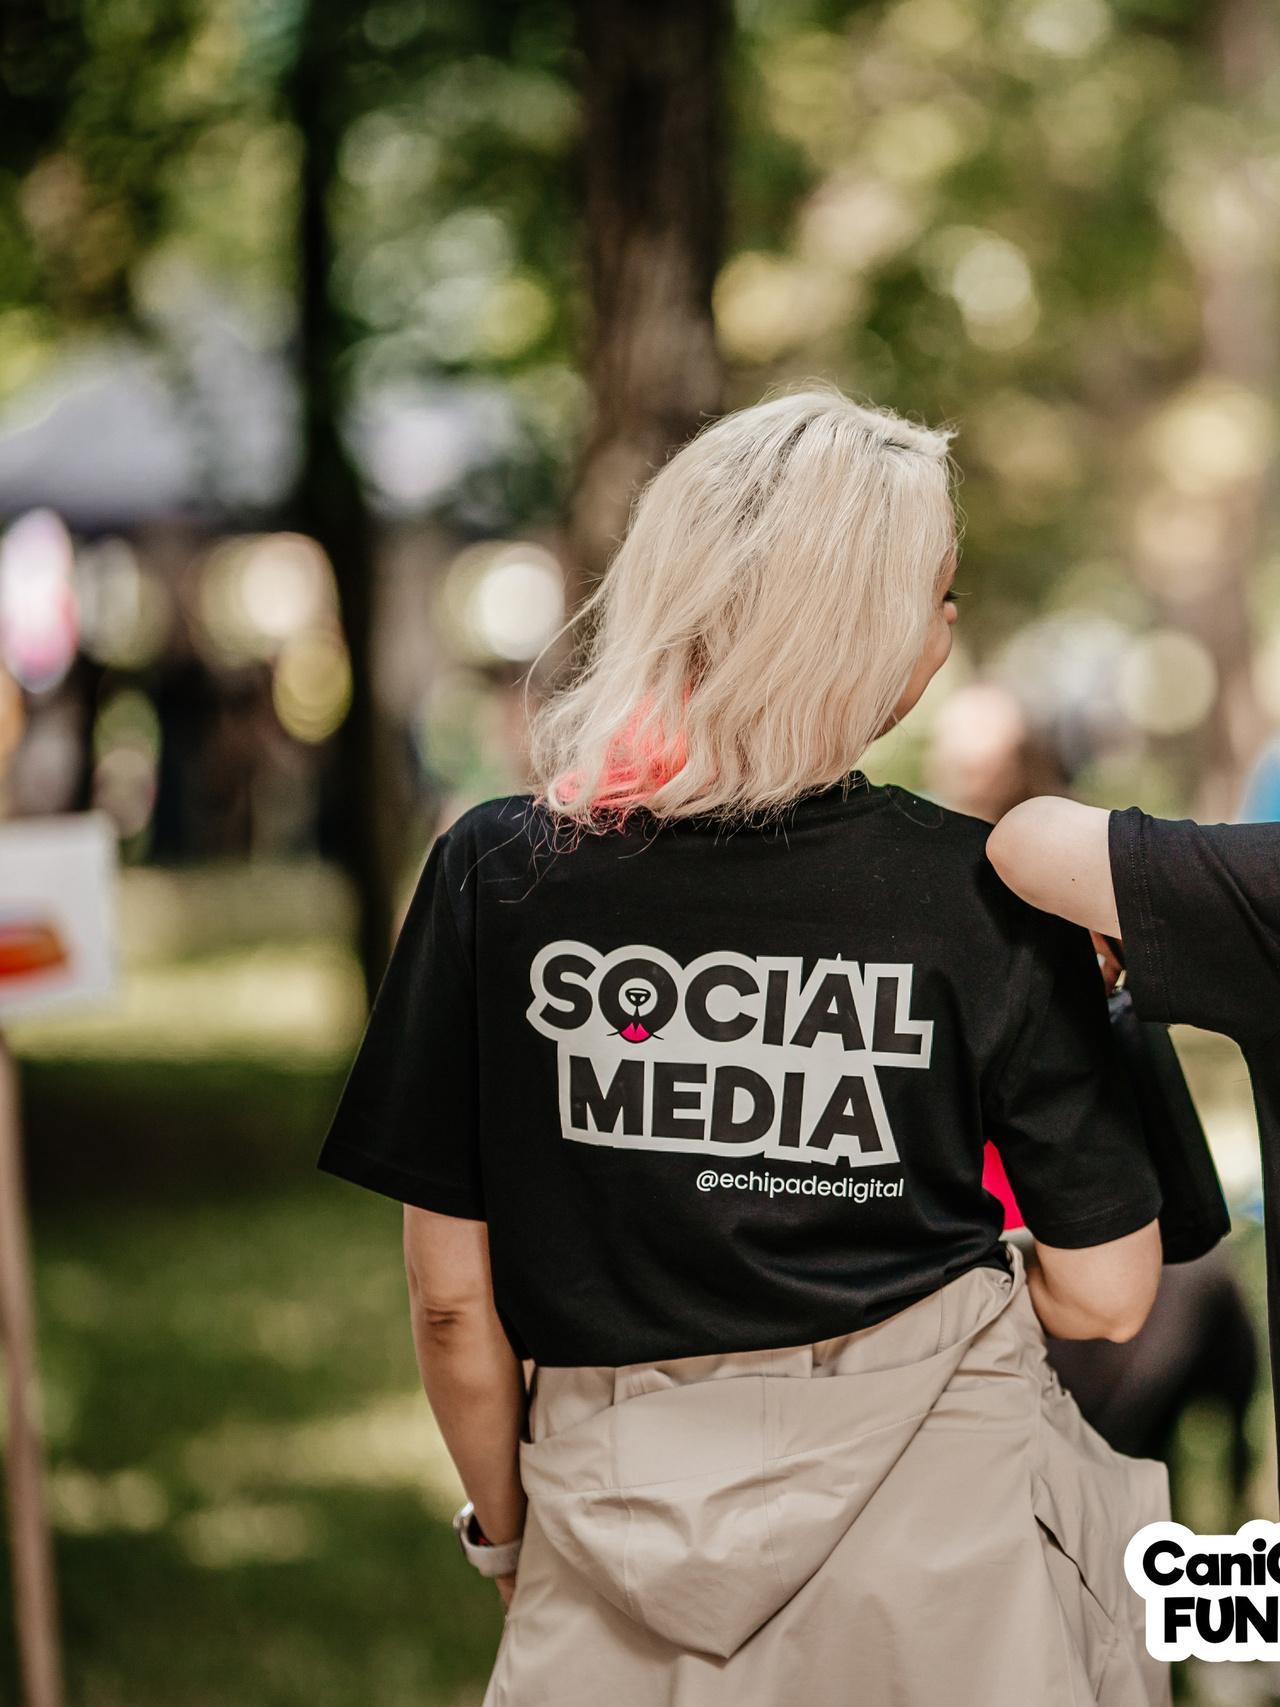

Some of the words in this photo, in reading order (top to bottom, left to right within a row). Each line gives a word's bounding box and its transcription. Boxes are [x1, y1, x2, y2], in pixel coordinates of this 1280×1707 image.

[538, 953, 923, 1056] SOCIAL
[569, 1054, 883, 1154] MEDIA
[696, 1169, 905, 1204] @echipadedigital
